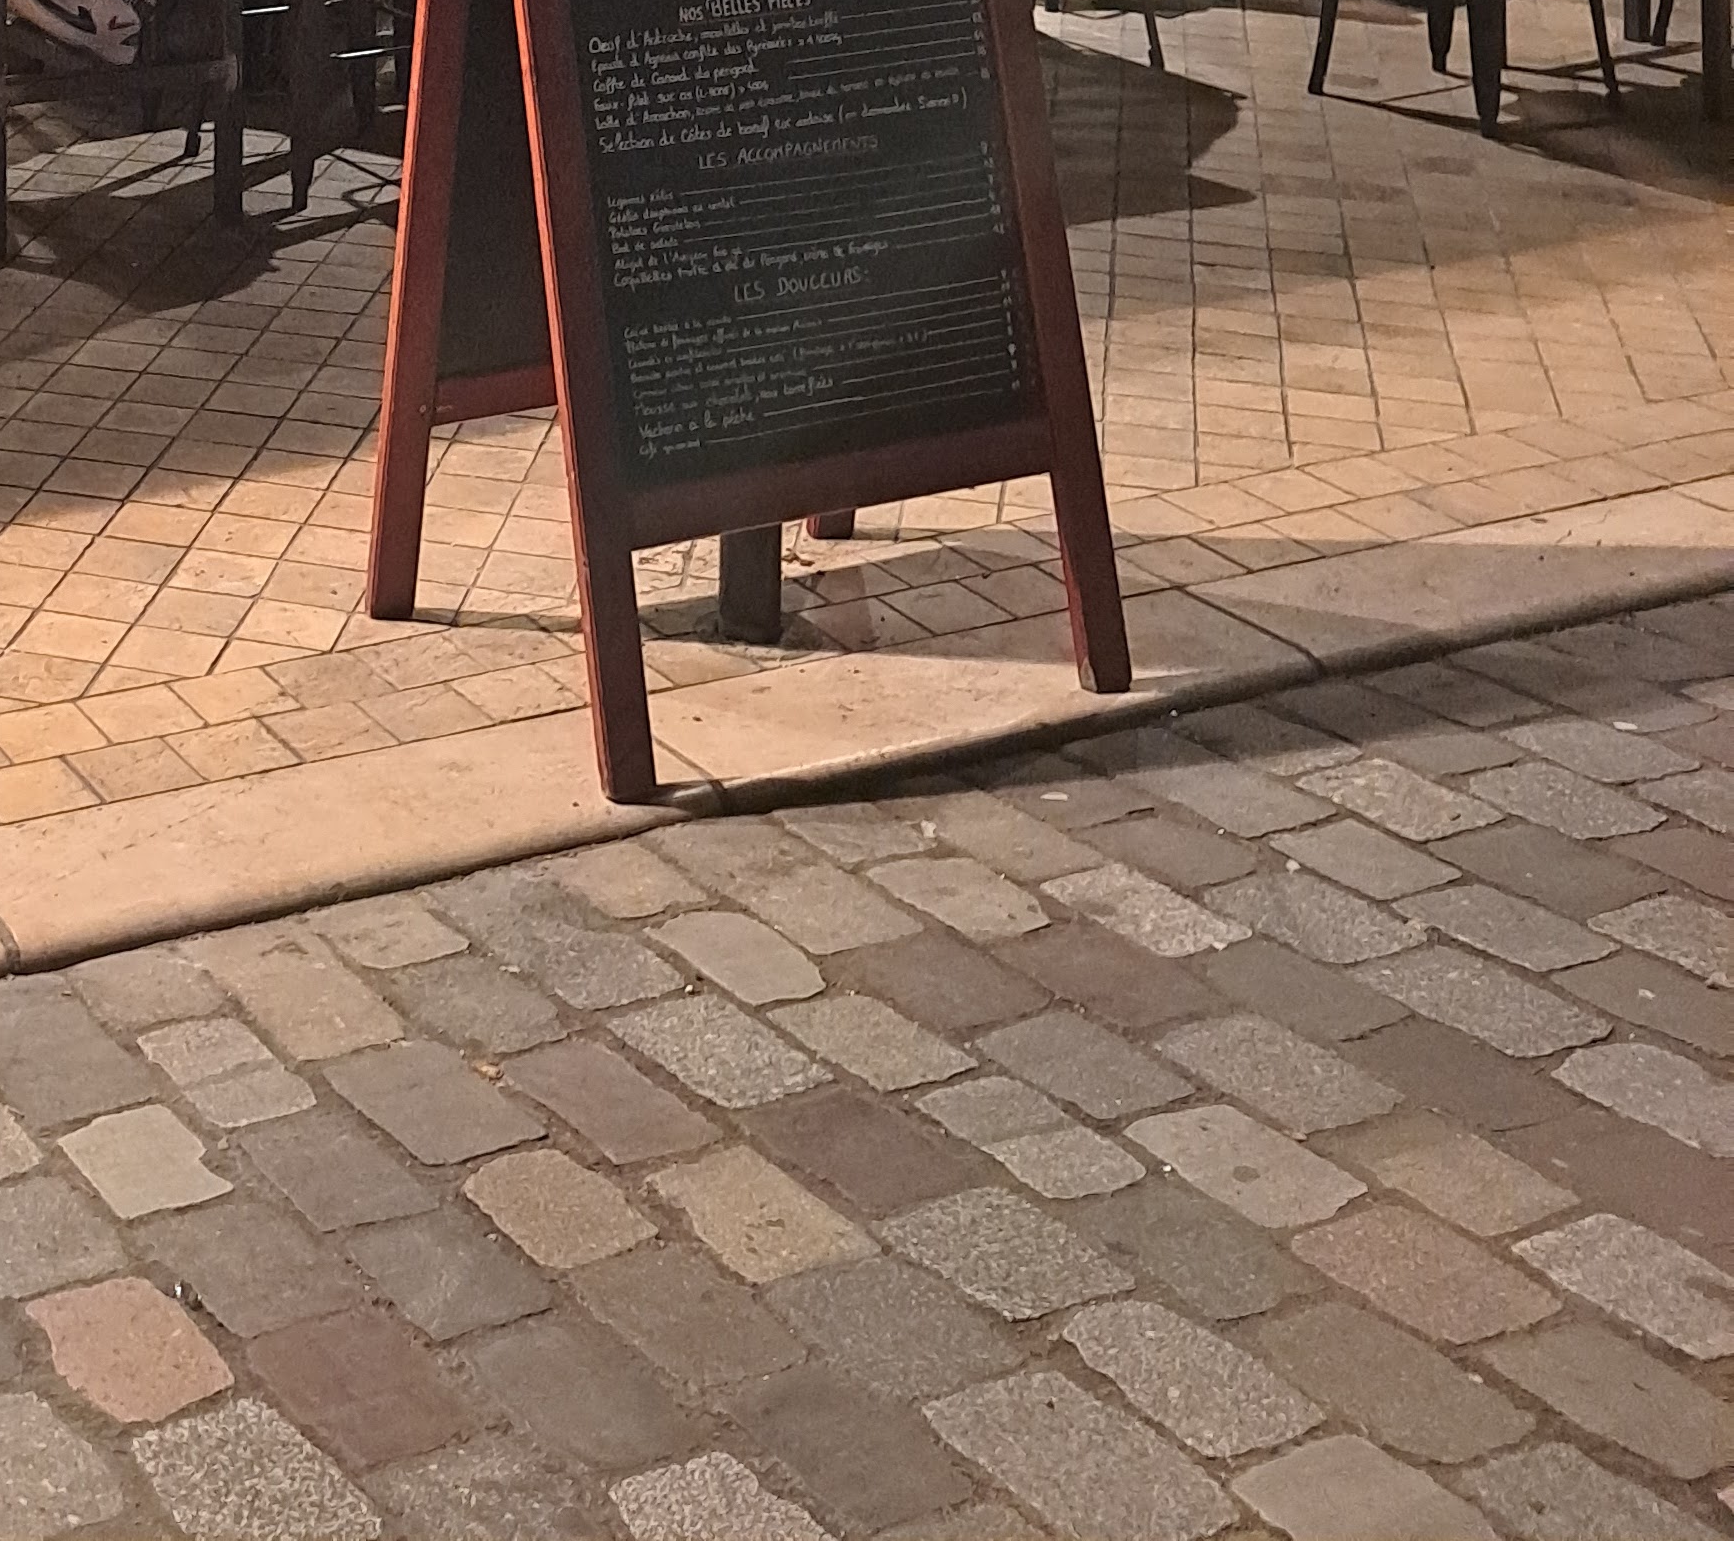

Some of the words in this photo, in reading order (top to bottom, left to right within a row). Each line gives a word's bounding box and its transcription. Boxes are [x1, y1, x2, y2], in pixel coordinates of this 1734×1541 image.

[679, 6, 703, 21] NOS
[698, 151, 727, 169] LES
[737, 135, 877, 163] ACCOMPAGNEMENTS
[733, 280, 765, 303] LES
